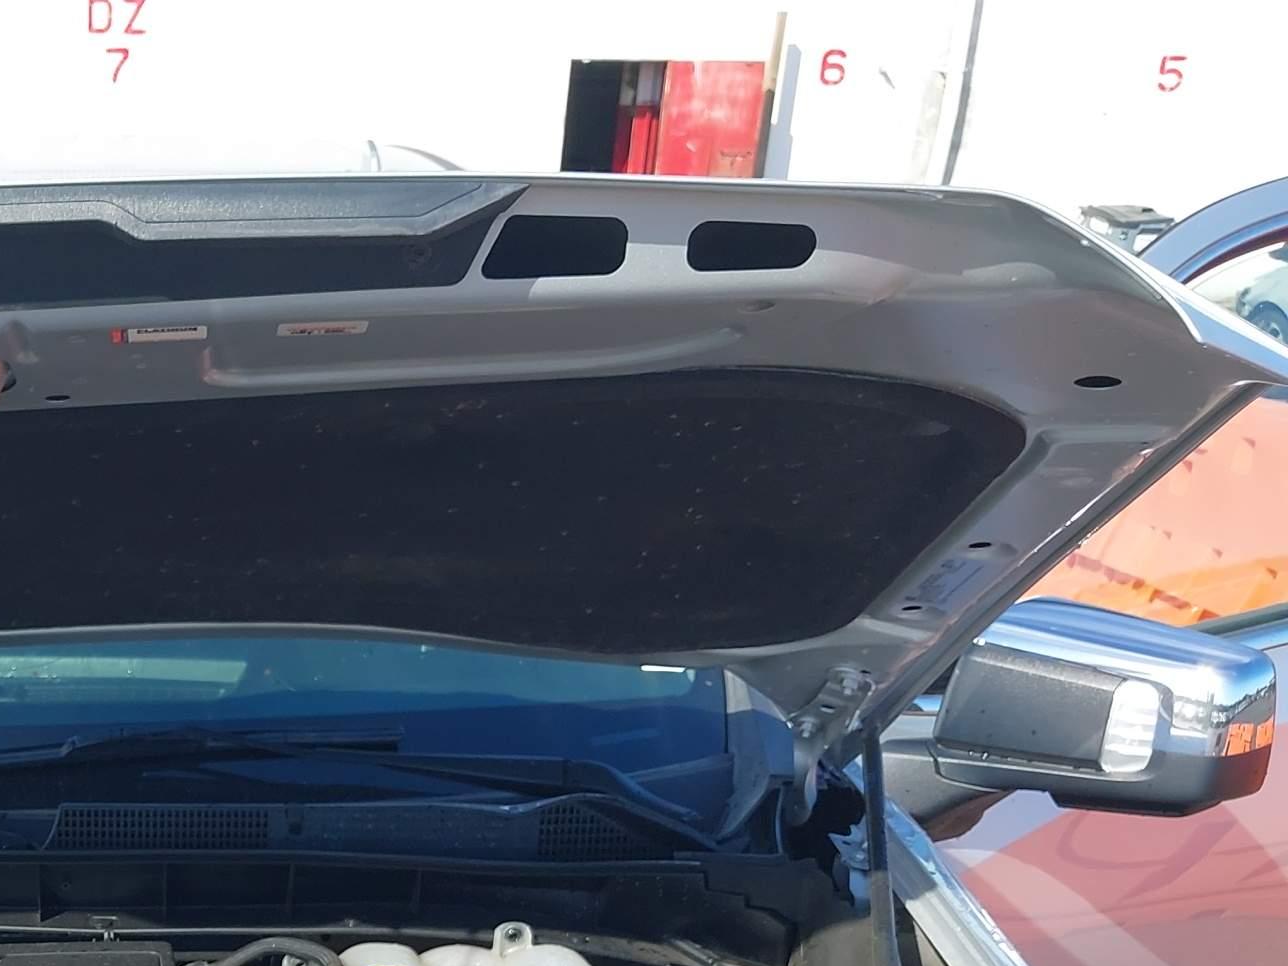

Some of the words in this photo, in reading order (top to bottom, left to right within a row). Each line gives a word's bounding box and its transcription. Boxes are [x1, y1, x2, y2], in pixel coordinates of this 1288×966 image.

[88, 0, 146, 35] DZ
[106, 48, 130, 83] 7
[819, 48, 848, 86] 6
[1158, 55, 1187, 92] 5
